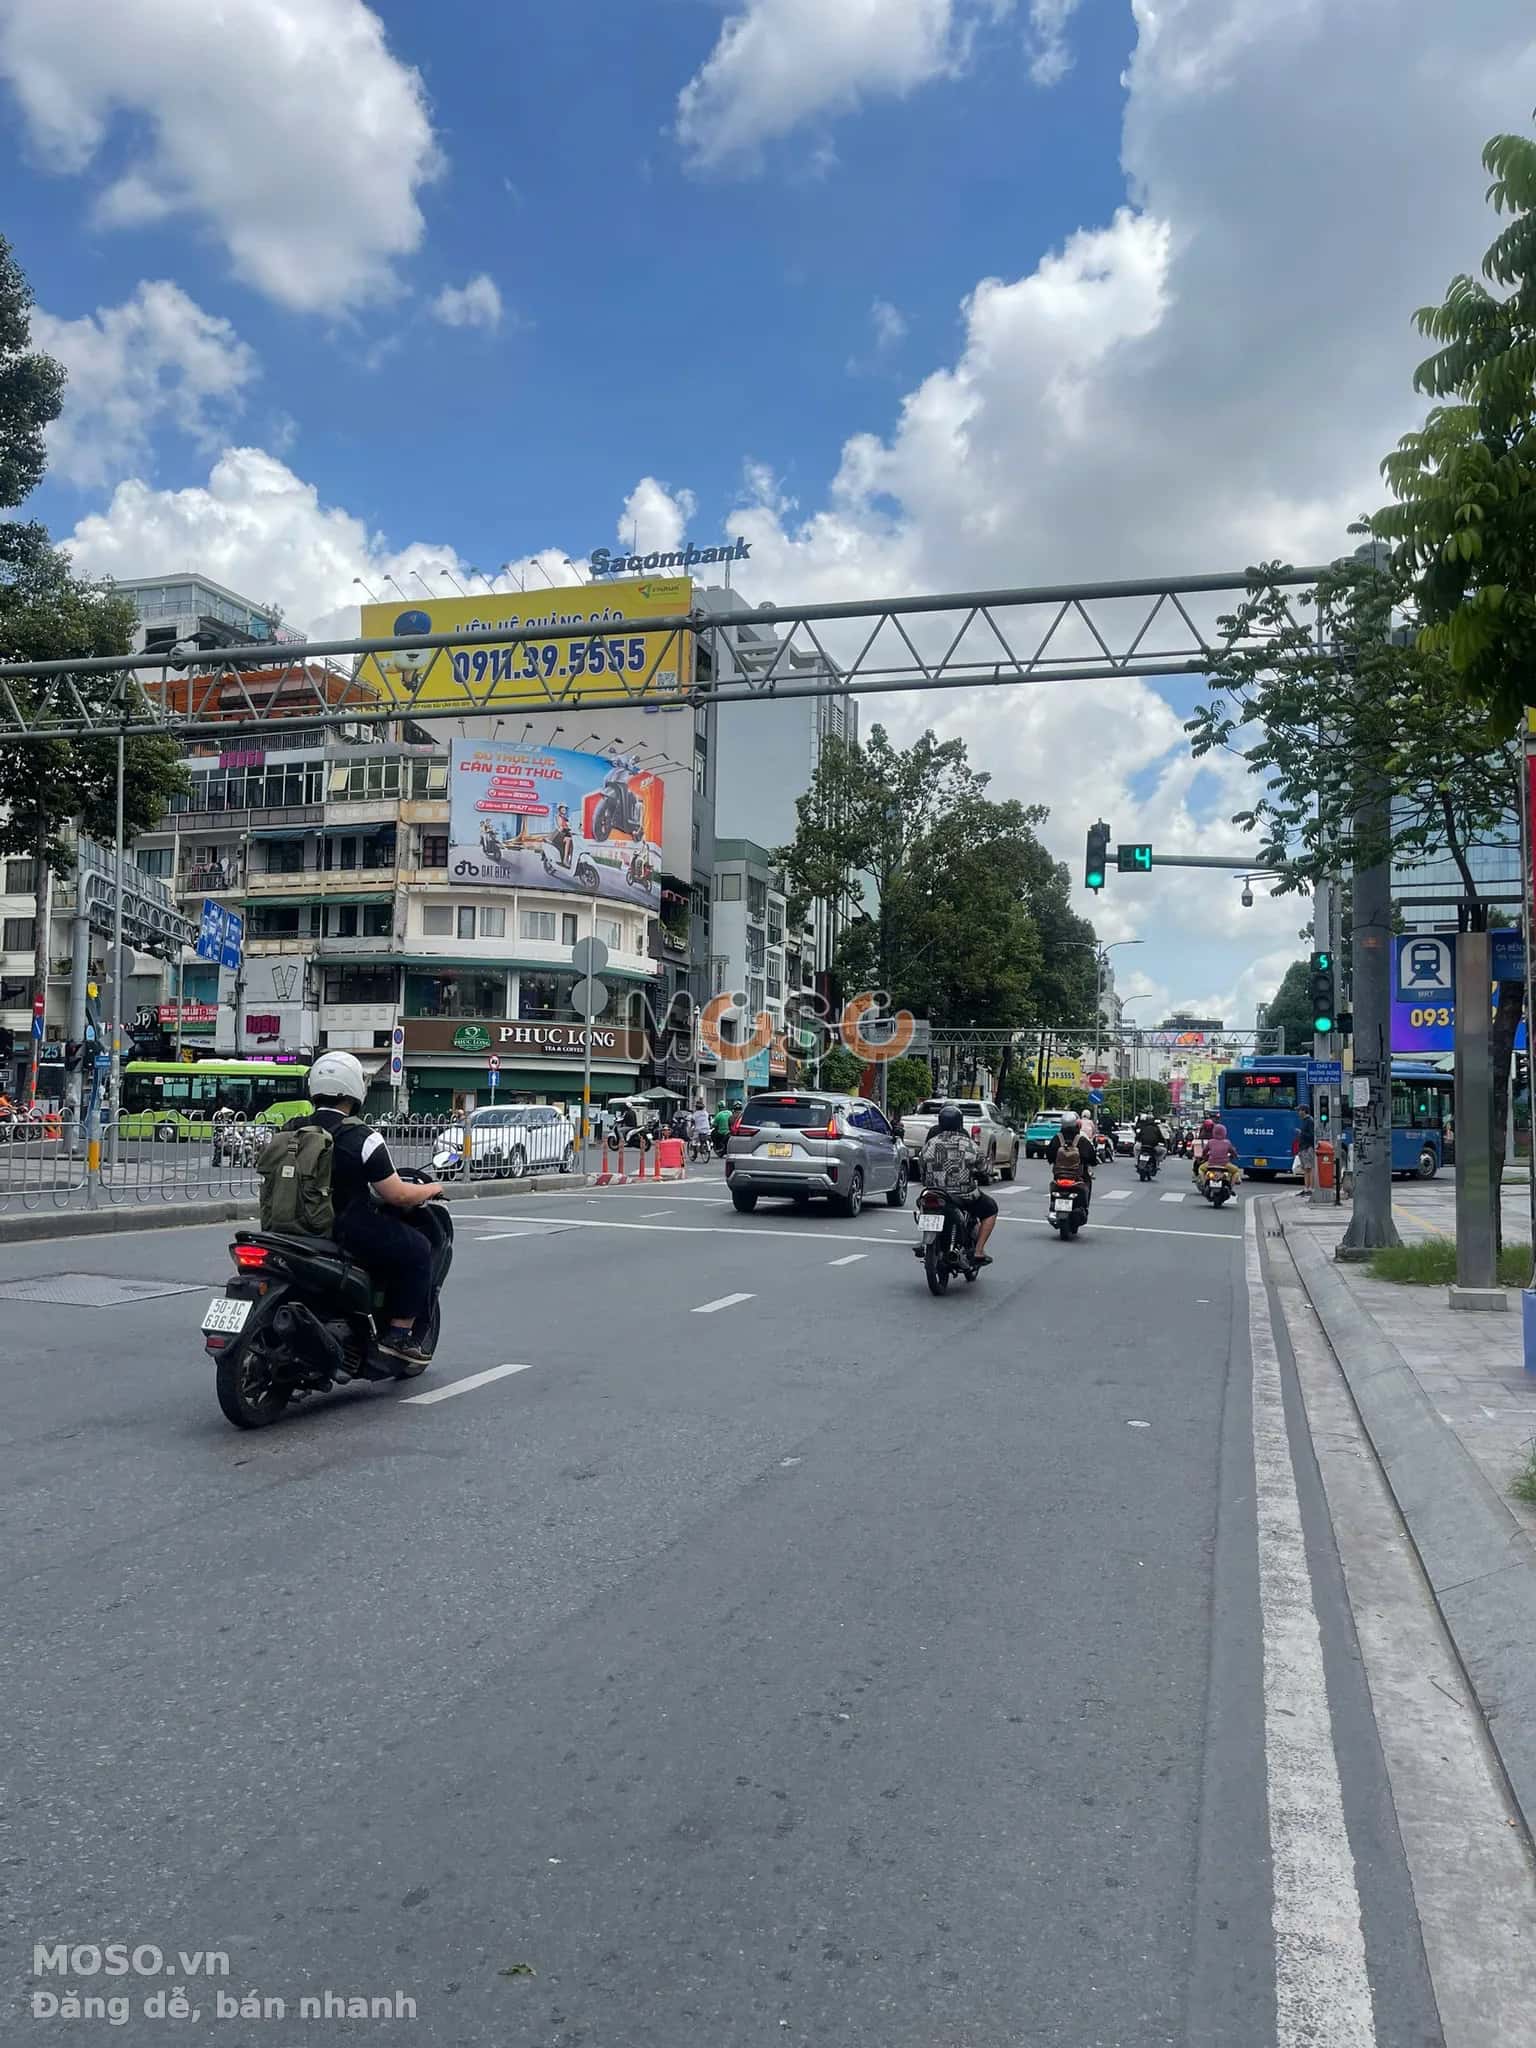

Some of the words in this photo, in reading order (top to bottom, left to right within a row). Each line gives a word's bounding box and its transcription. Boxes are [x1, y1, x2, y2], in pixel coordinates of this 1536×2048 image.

[589, 536, 752, 575] Sacombank
[453, 639, 646, 684] 0911.39.5555
[1135, 847, 1150, 869] 4
[499, 1026, 563, 1044] PHUC
[567, 1030, 616, 1047] LONG
